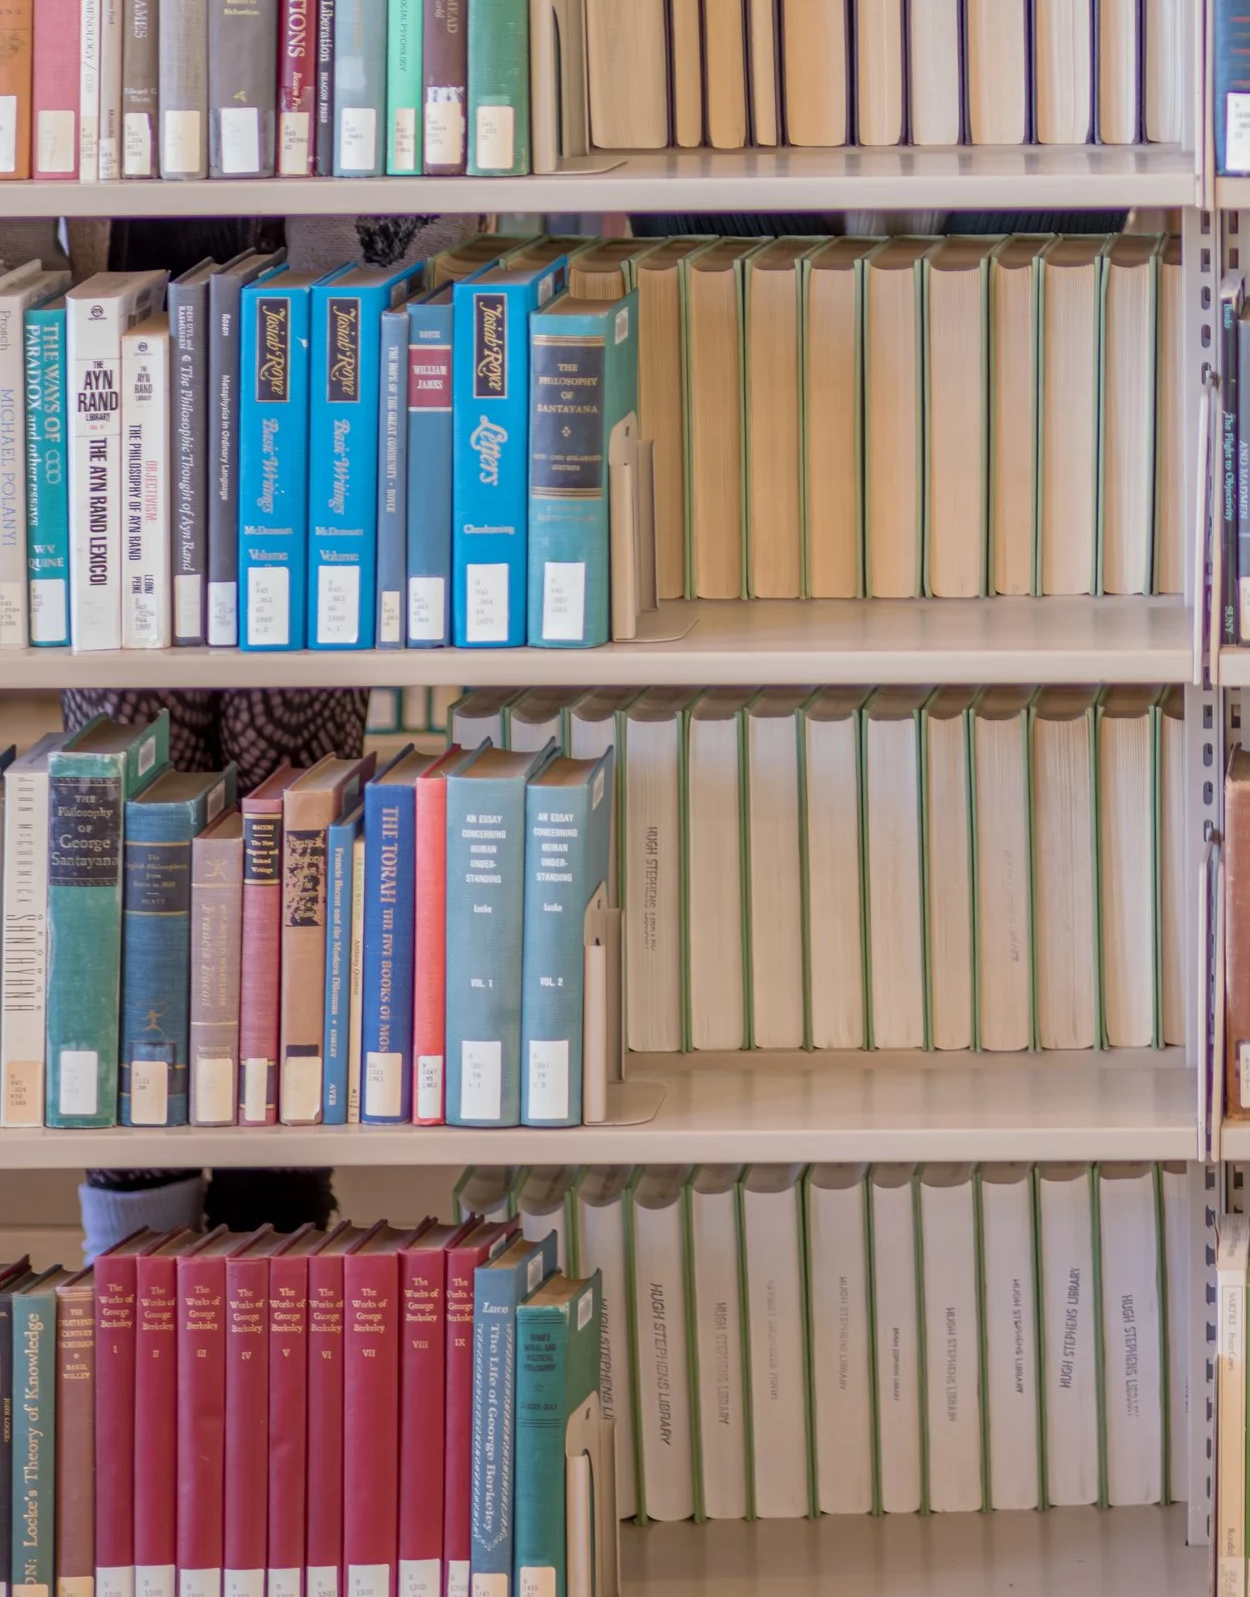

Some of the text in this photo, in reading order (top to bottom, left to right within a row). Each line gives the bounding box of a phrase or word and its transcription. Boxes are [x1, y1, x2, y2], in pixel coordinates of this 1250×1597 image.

[320, 1, 335, 62] Liberation
[259, 306, 286, 397] Josiah Royce
[92, 360, 104, 370] THE
[558, 363, 578, 373] THE
[42, 322, 61, 443] THE WAYS OF
[83, 369, 113, 391] AYN
[538, 376, 597, 387] PHILOSOPHY
[77, 391, 119, 413] RAND
[560, 391, 574, 400] OF
[85, 412, 111, 423] LIBRARY
[536, 404, 598, 414] SANTAYANA
[89, 437, 107, 462] THE
[89, 465, 107, 491] AYN
[177, 366, 194, 571] The Philosophic Thought of Ayn Rand
[89, 495, 107, 533] RAND
[74, 794, 96, 804] THE
[57, 807, 113, 819] Philosophy
[77, 824, 93, 834] OF
[59, 835, 111, 851] George
[51, 852, 119, 867] Santayana
[380, 806, 399, 903] THE TORAH
[22, 1313, 42, 1547] Locke's Theory of Knowledge
